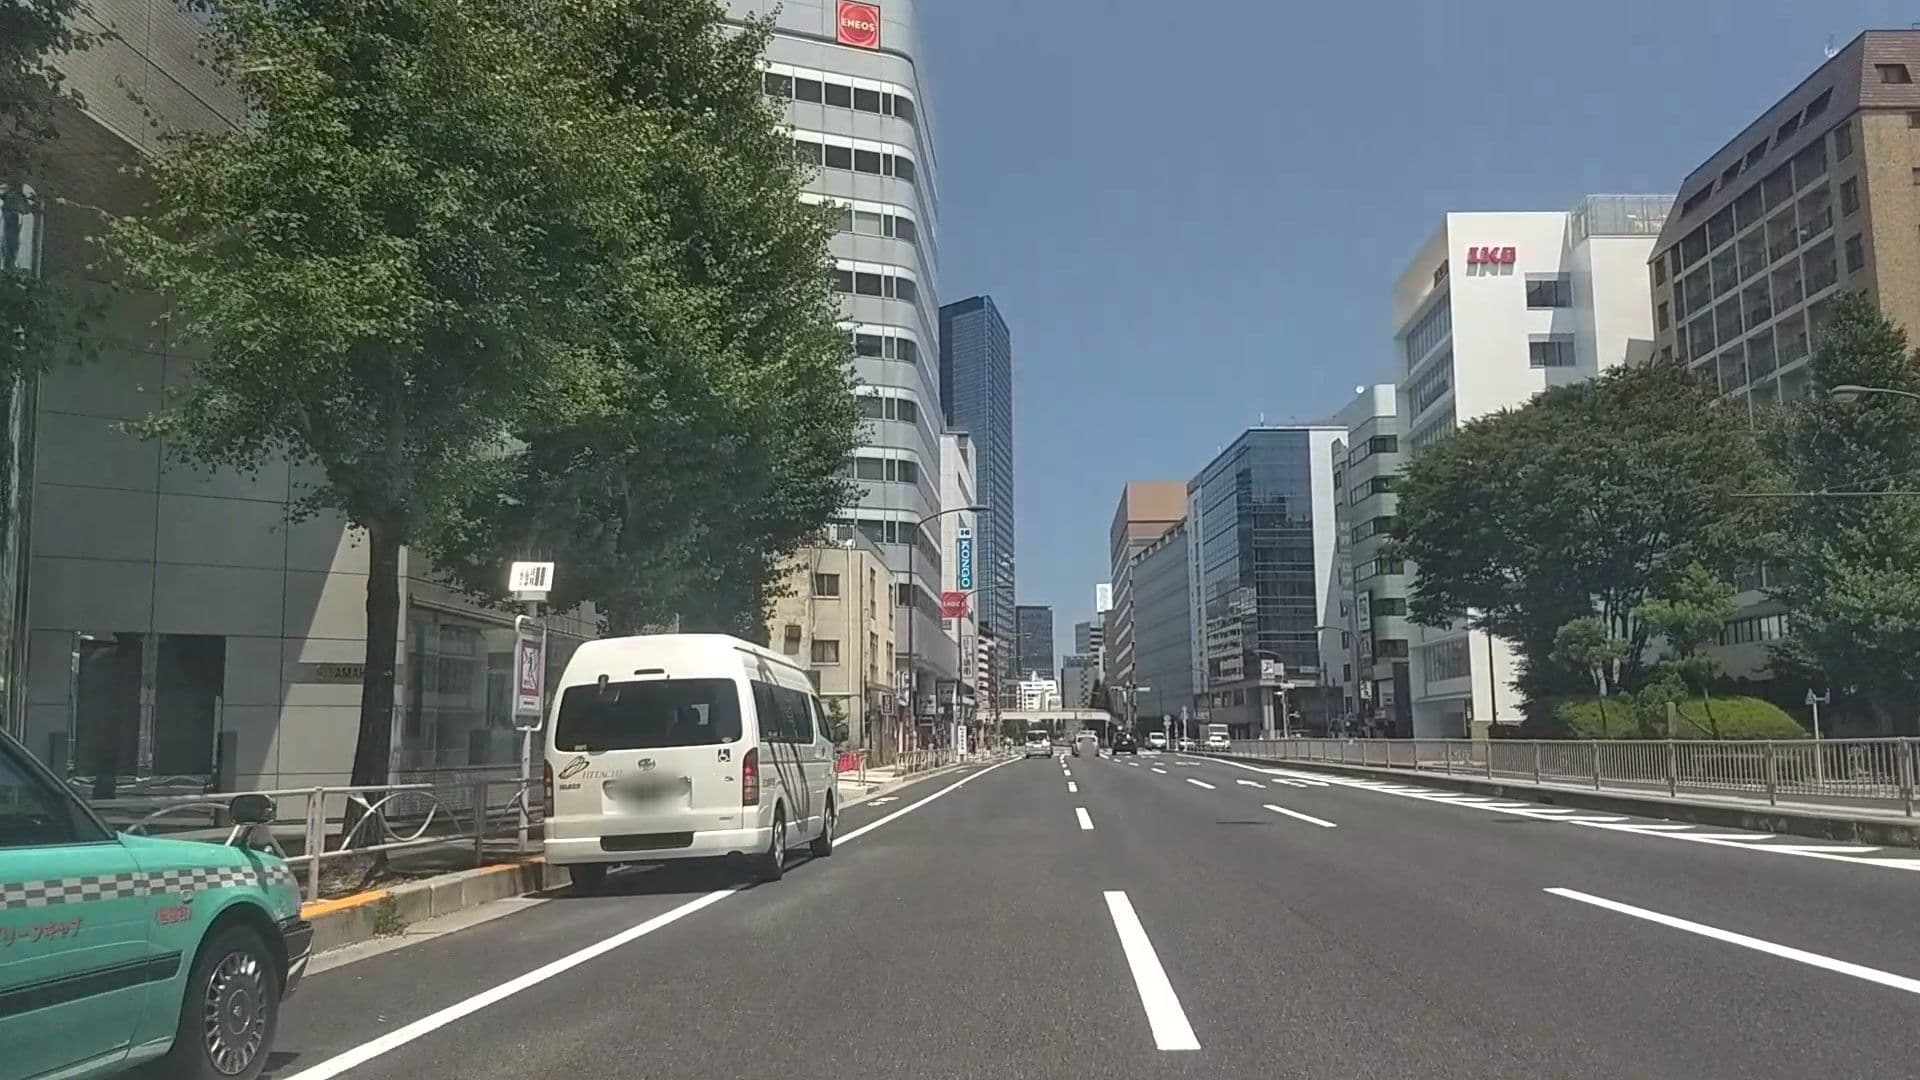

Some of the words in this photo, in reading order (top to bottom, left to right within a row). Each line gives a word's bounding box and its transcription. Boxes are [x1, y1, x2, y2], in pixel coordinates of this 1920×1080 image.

[841, 17, 876, 32] ENEOS
[961, 539, 970, 588] KONGO
[582, 768, 623, 780] HITACHI
